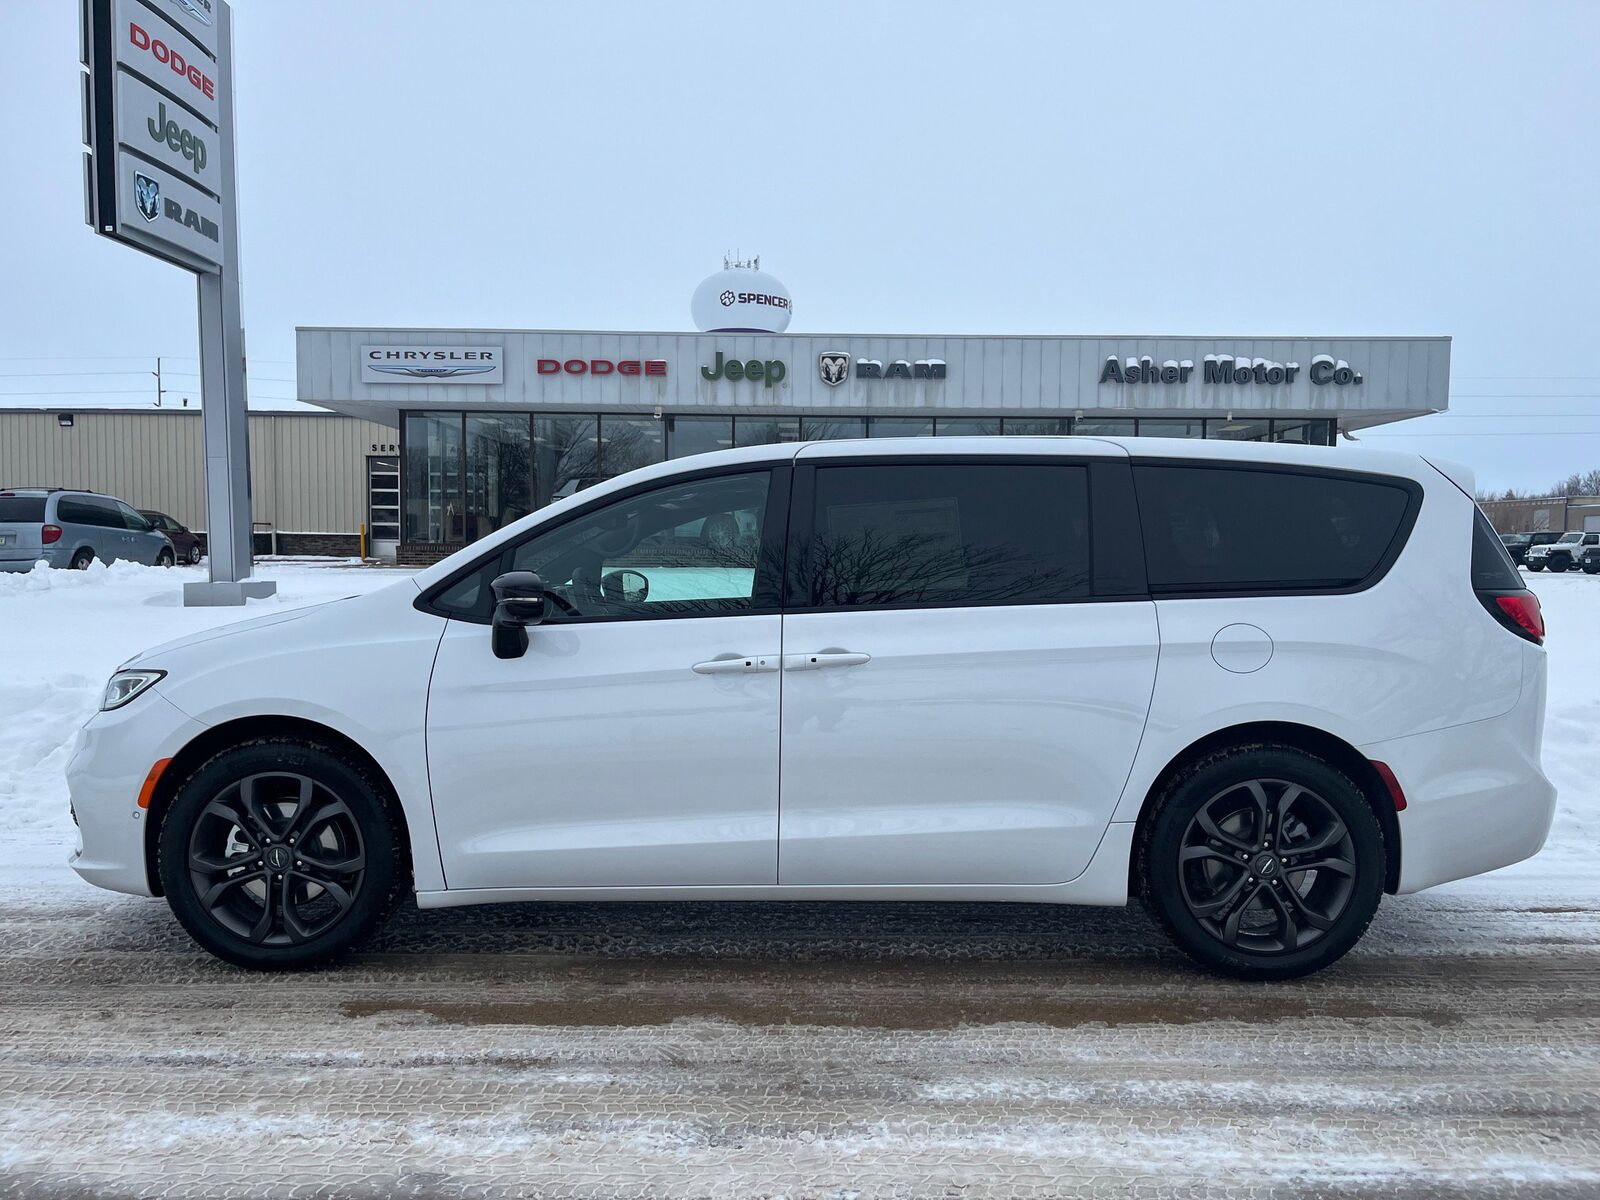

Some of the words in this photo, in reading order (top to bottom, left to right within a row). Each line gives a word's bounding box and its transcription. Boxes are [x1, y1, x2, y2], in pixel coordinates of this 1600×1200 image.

[130, 22, 215, 101] DODGE
[147, 101, 207, 174] Jeep
[163, 197, 219, 243] RAM
[738, 292, 788, 310] SPENCER
[369, 351, 493, 360] CHRYSLER
[537, 359, 666, 376] DODGE
[701, 351, 786, 388] Jeep
[856, 361, 946, 379] RAM
[1099, 359, 1194, 384] Asher
[1203, 359, 1300, 385] Motor
[1310, 359, 1363, 385] Co.
